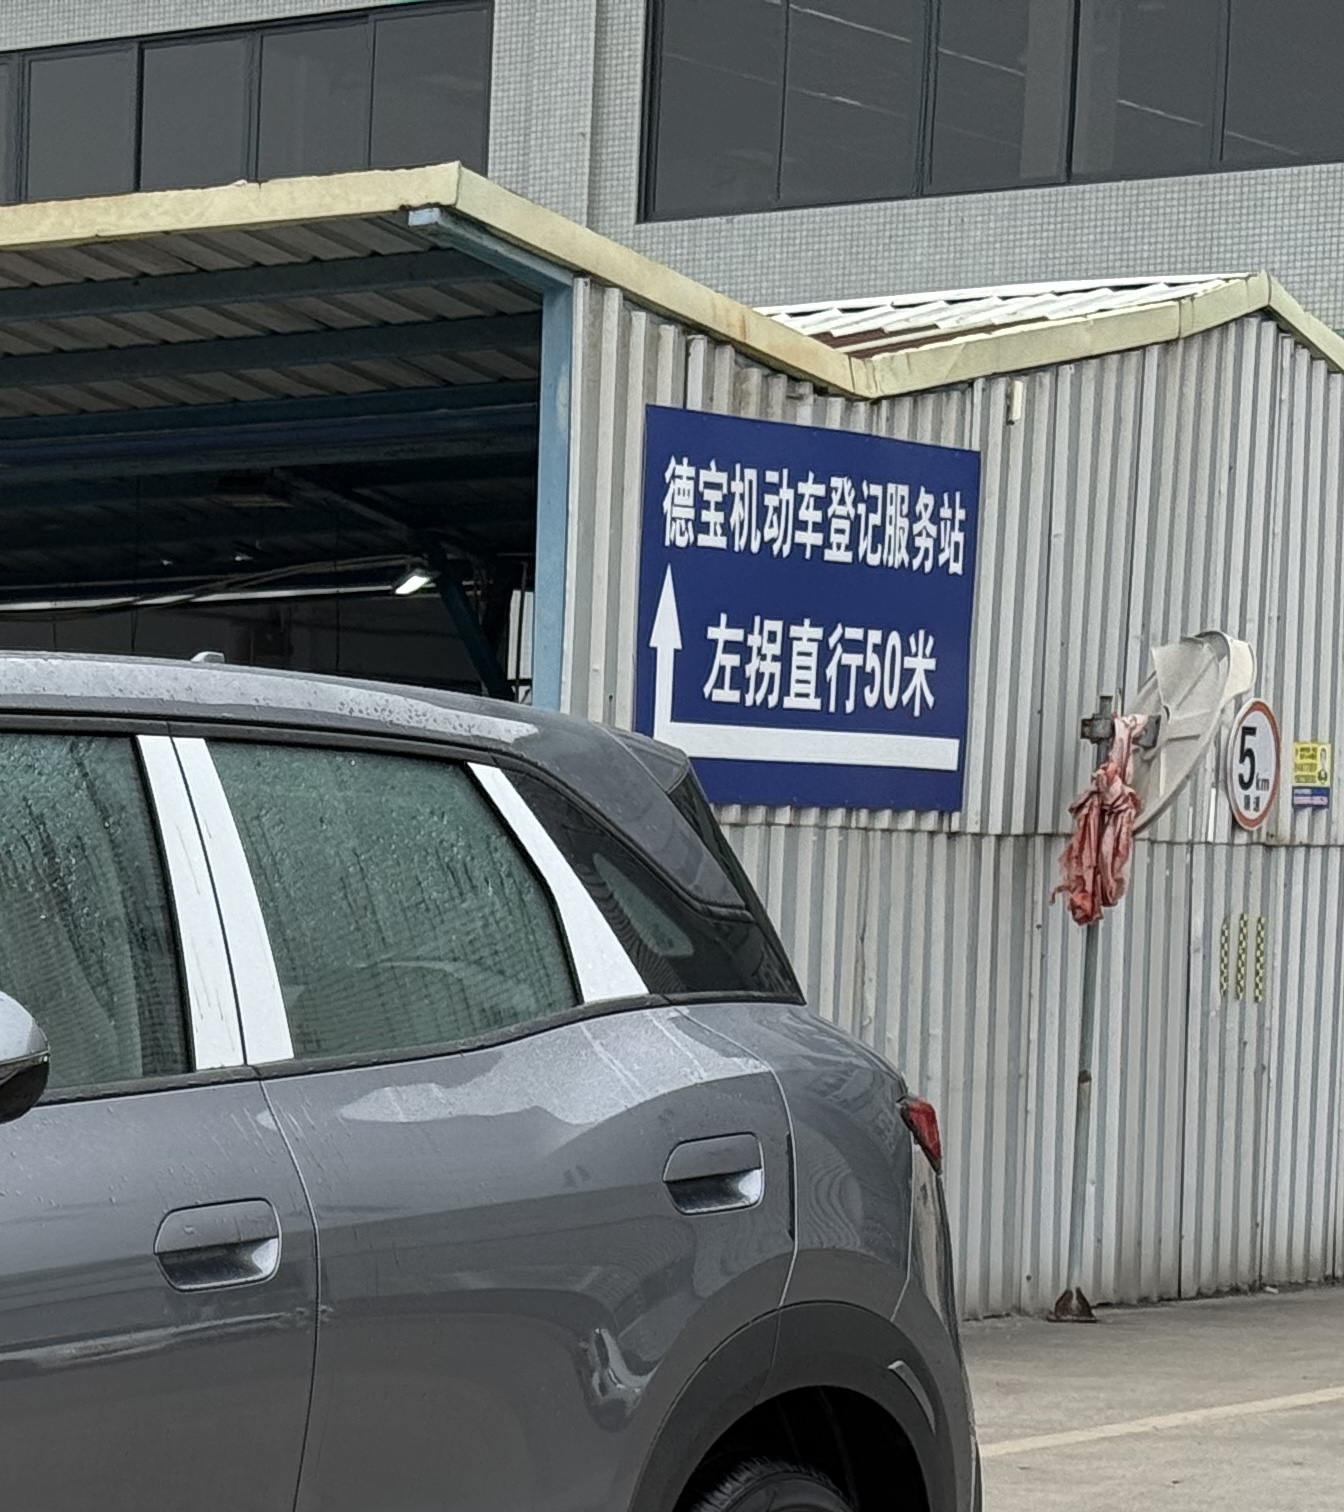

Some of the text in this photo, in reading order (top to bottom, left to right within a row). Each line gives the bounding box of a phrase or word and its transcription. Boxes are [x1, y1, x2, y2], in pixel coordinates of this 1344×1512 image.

[663, 455, 967, 575] 德宝机动车登记服务站
[703, 612, 937, 717] 左拐直行50米
